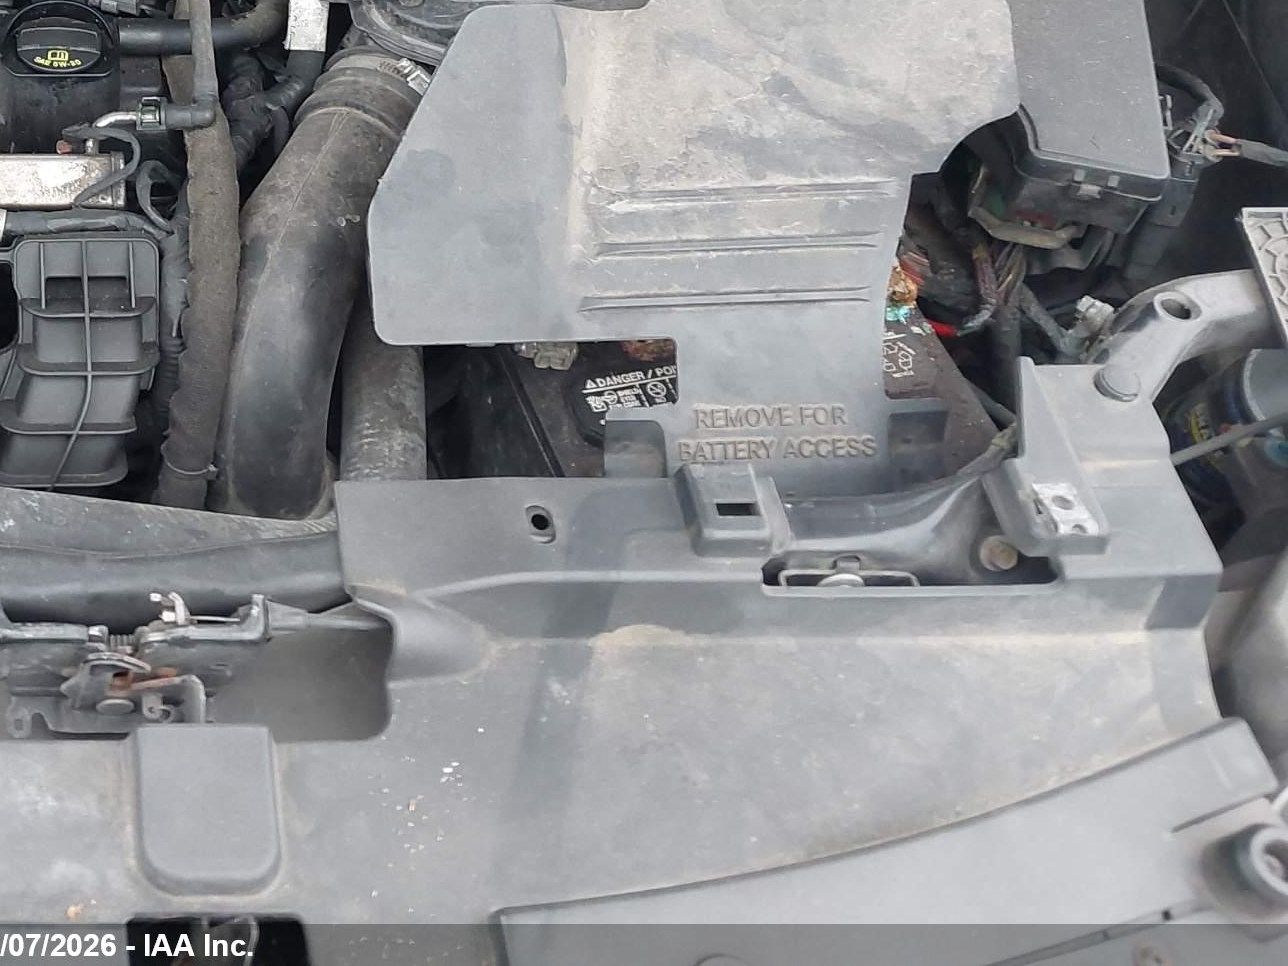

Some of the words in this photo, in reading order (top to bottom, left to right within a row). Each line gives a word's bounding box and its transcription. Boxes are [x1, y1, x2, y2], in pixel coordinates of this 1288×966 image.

[33, 56, 52, 67] SAE
[595, 371, 646, 387] DANGER
[647, 369, 653, 379] /
[655, 365, 677, 377] POI
[693, 404, 793, 429] REMOVE
[799, 403, 848, 426] FOR
[678, 437, 776, 461] BATTERY
[783, 435, 877, 459] ACCESS
